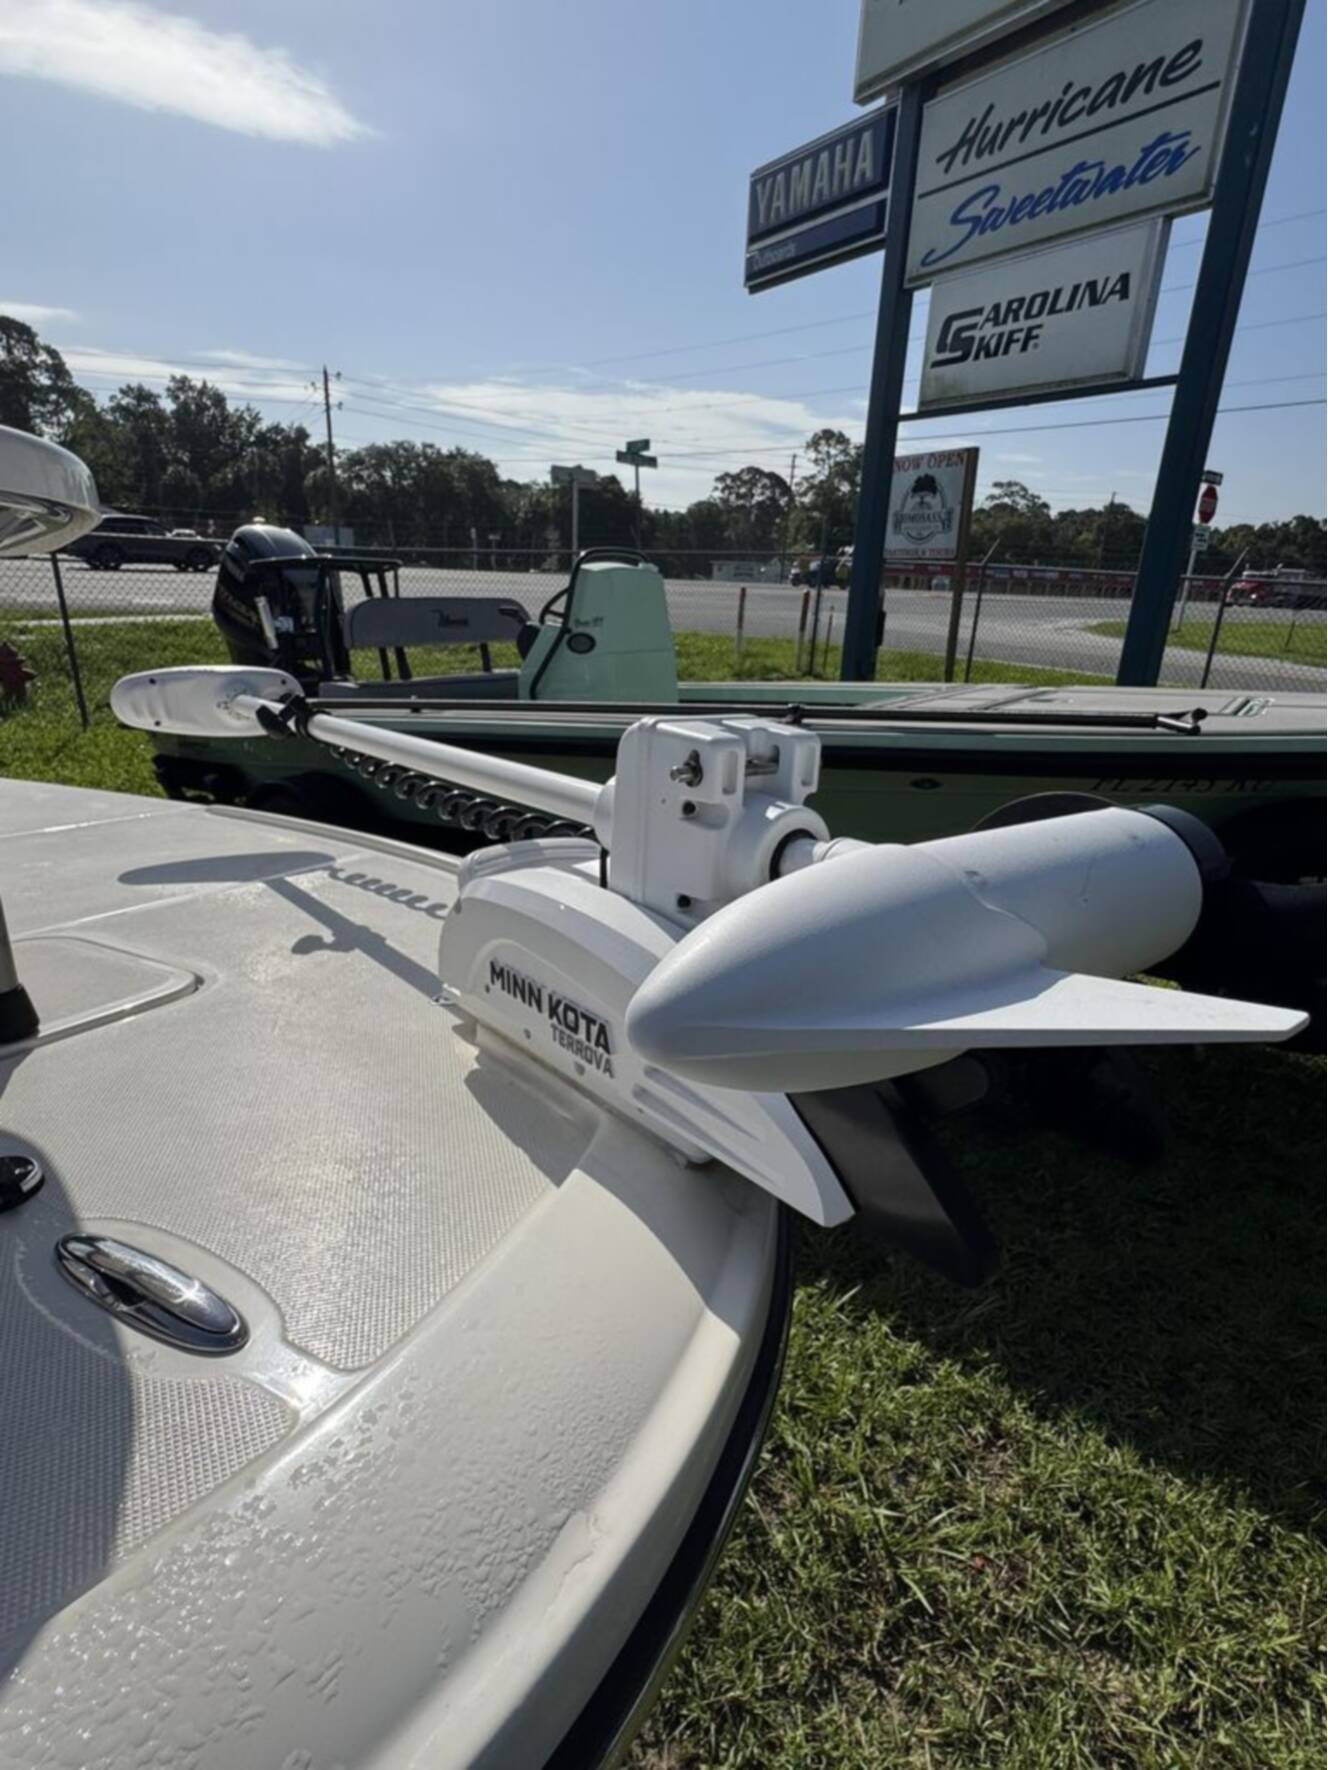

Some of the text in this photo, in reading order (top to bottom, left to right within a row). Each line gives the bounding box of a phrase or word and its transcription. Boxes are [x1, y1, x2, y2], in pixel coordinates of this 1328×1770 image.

[935, 38, 1203, 174] Hurricane
[756, 129, 875, 225] YAMAHA
[920, 130, 1202, 268] Sweetwater
[930, 321, 1044, 370] SKIFF
[936, 272, 1131, 354] CAROLINA
[892, 451, 965, 473] NOW OPEN
[490, 960, 611, 1055] MINN KOTA
[550, 1022, 615, 1079] TERROVA
